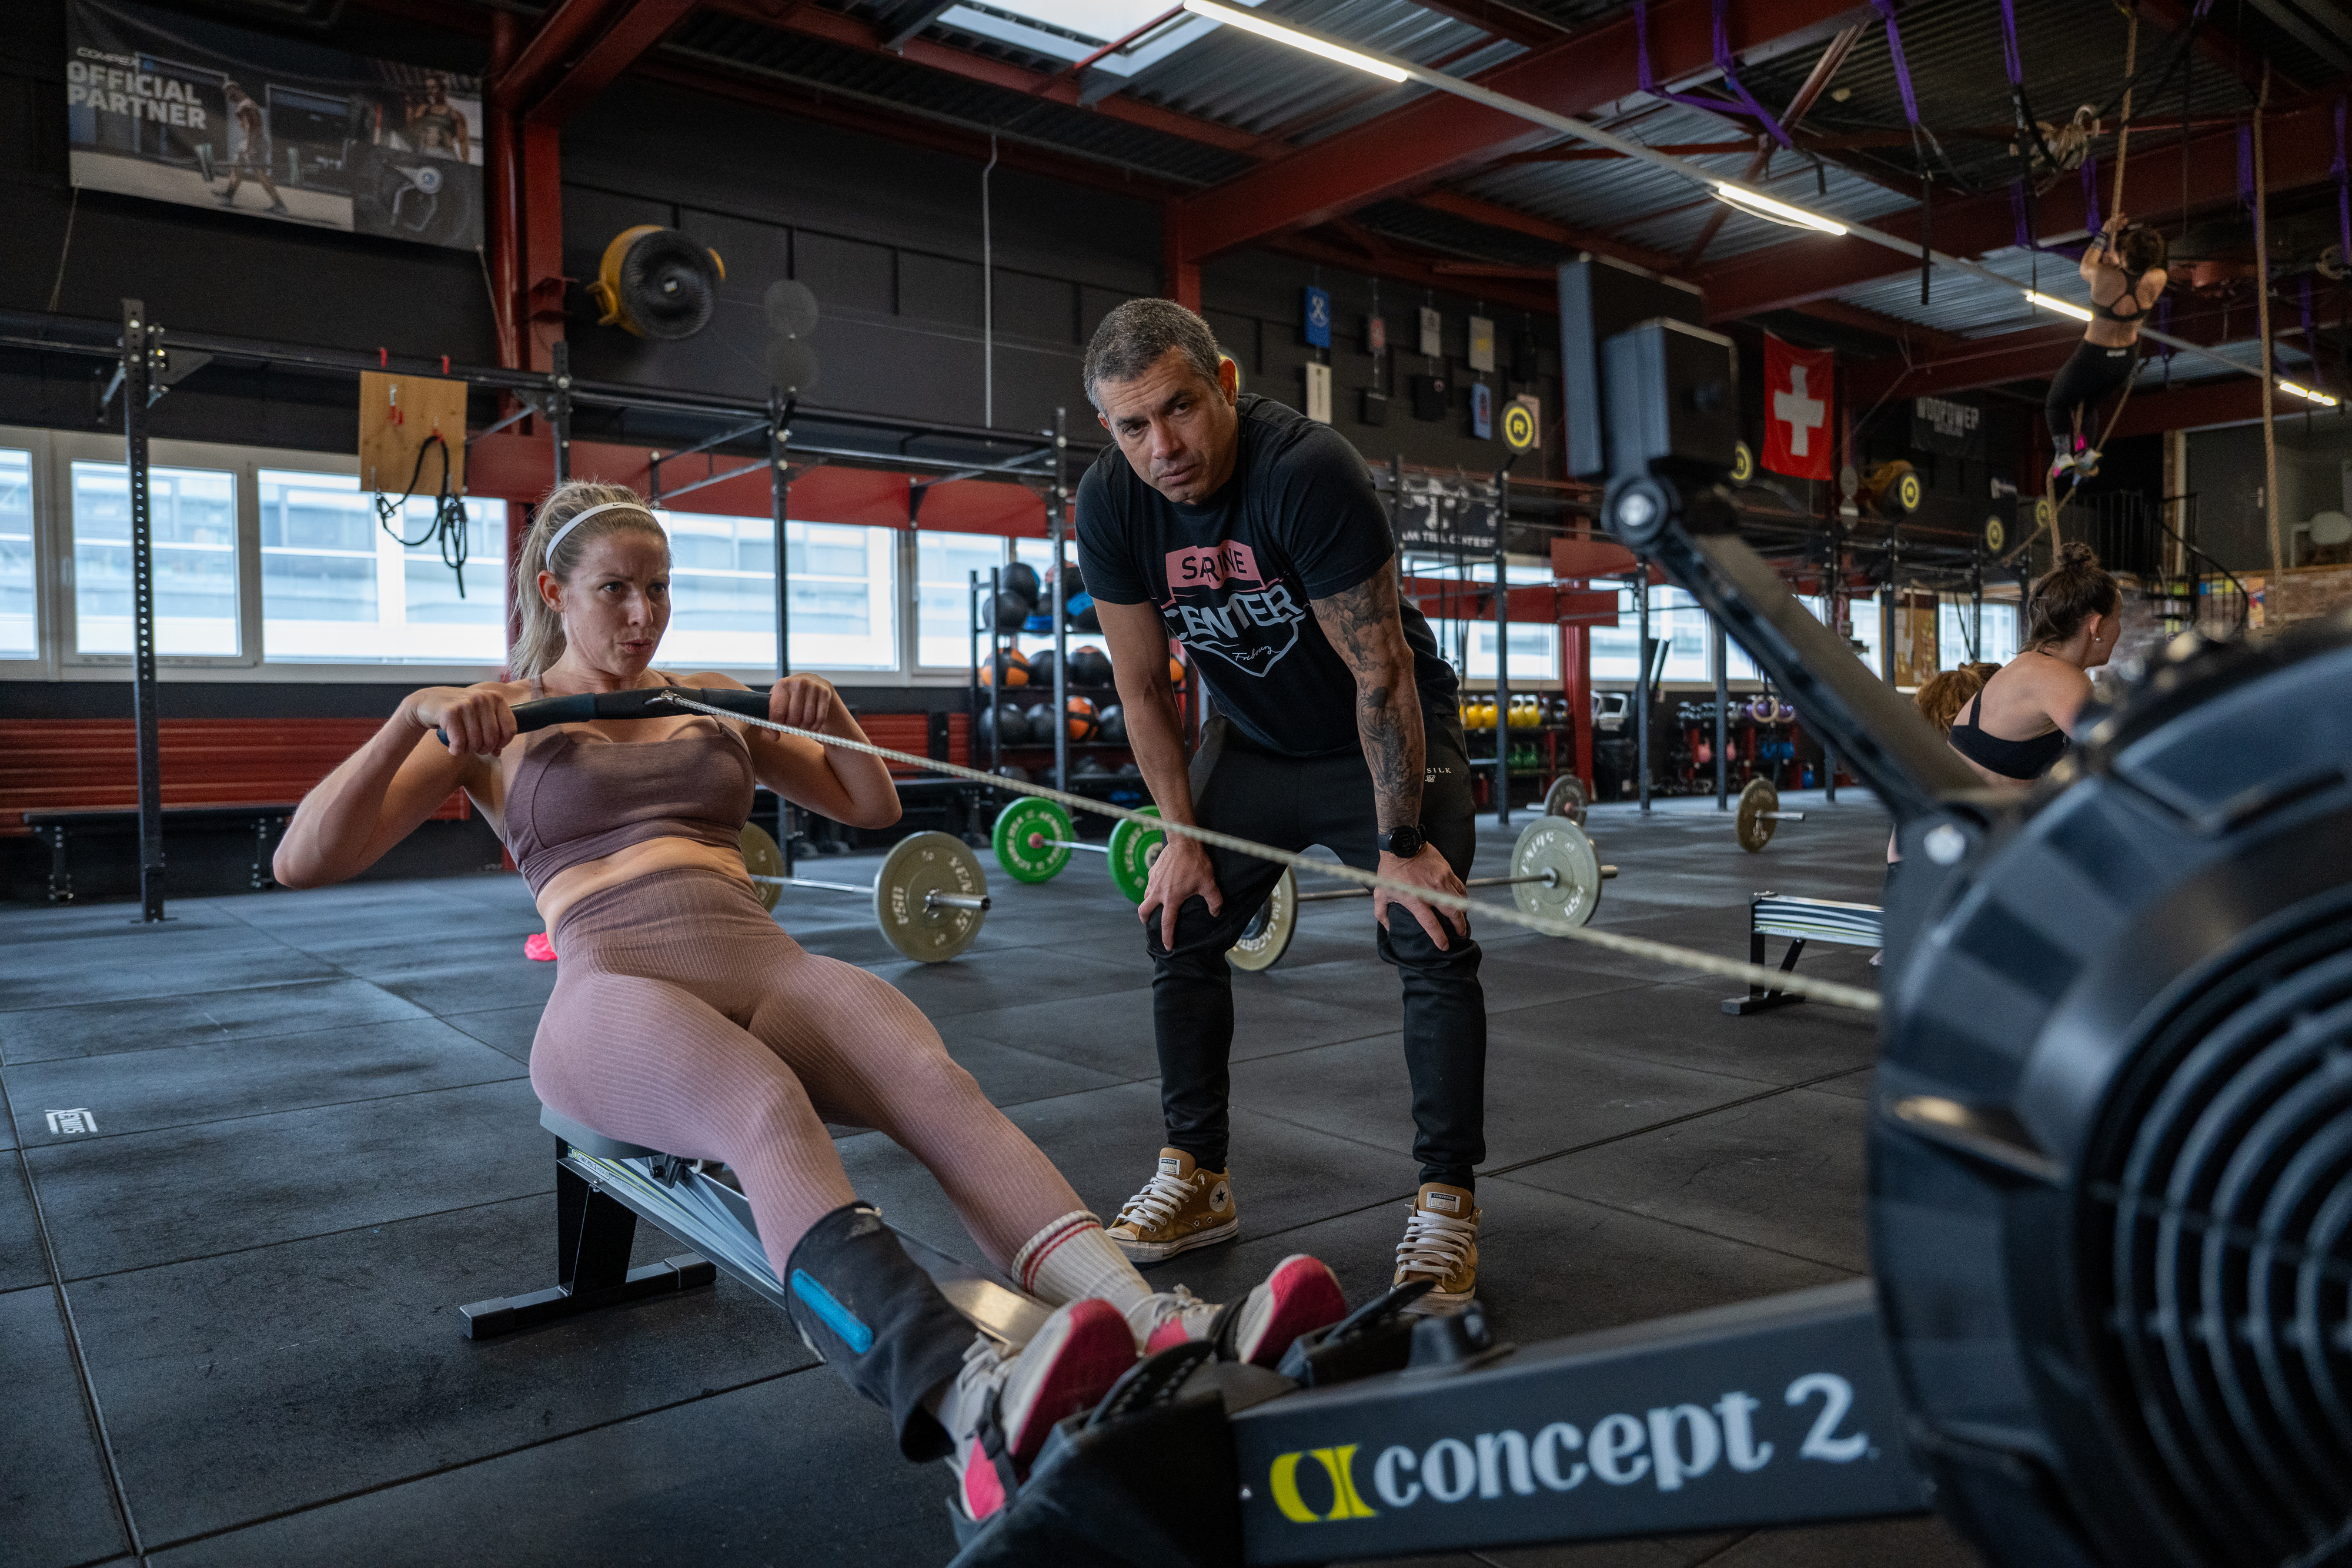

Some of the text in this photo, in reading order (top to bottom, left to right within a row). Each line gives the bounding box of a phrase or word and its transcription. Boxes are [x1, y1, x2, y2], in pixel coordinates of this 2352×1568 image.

[67, 60, 201, 106] OFFICIAL
[68, 83, 207, 130] PARTNER
[1513, 419, 1525, 436] R
[1449, 533, 1496, 548] CNTEST
[1181, 548, 1248, 583] SARINE
[1232, 645, 1275, 661] Fribourg
